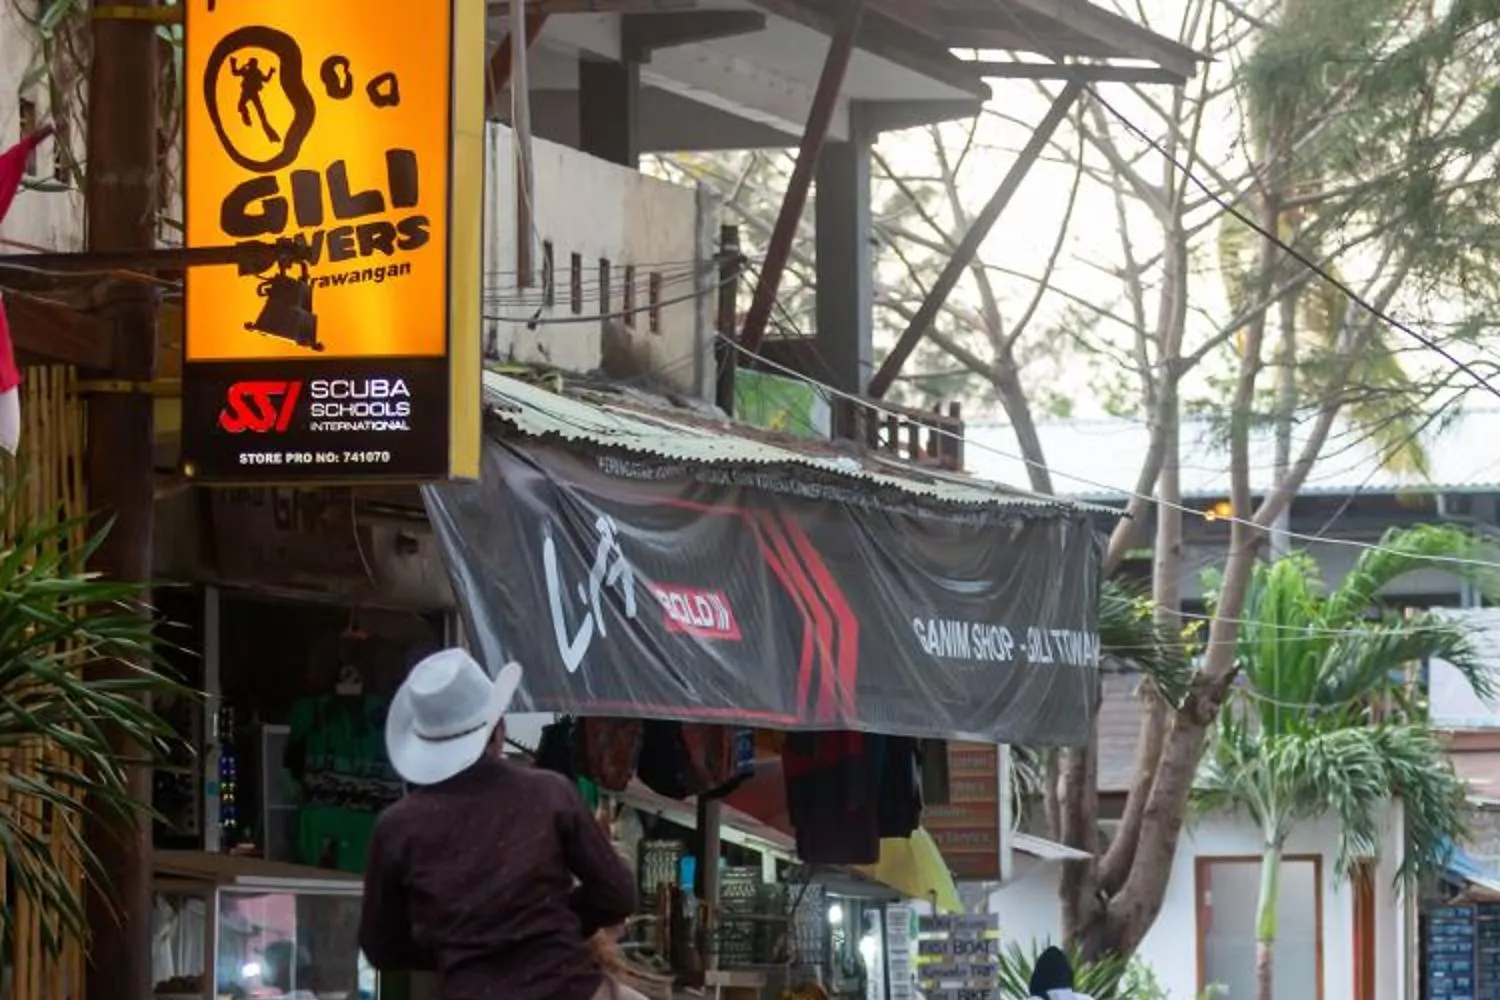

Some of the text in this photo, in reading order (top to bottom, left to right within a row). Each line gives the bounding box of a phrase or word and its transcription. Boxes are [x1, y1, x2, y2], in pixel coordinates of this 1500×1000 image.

[220, 148, 418, 237] GILI
[236, 216, 430, 276] DVERS
[310, 262, 411, 289] rawangan
[311, 379, 410, 399] SCUBA
[219, 380, 302, 433] SSI
[310, 402, 410, 417] SCHOOLS
[310, 420, 411, 431] INTERNATIONAL
[239, 453, 282, 464] STORE
[286, 452, 312, 463] PRO
[315, 452, 339, 463] NO:
[972, 623, 1014, 661] SHOP
